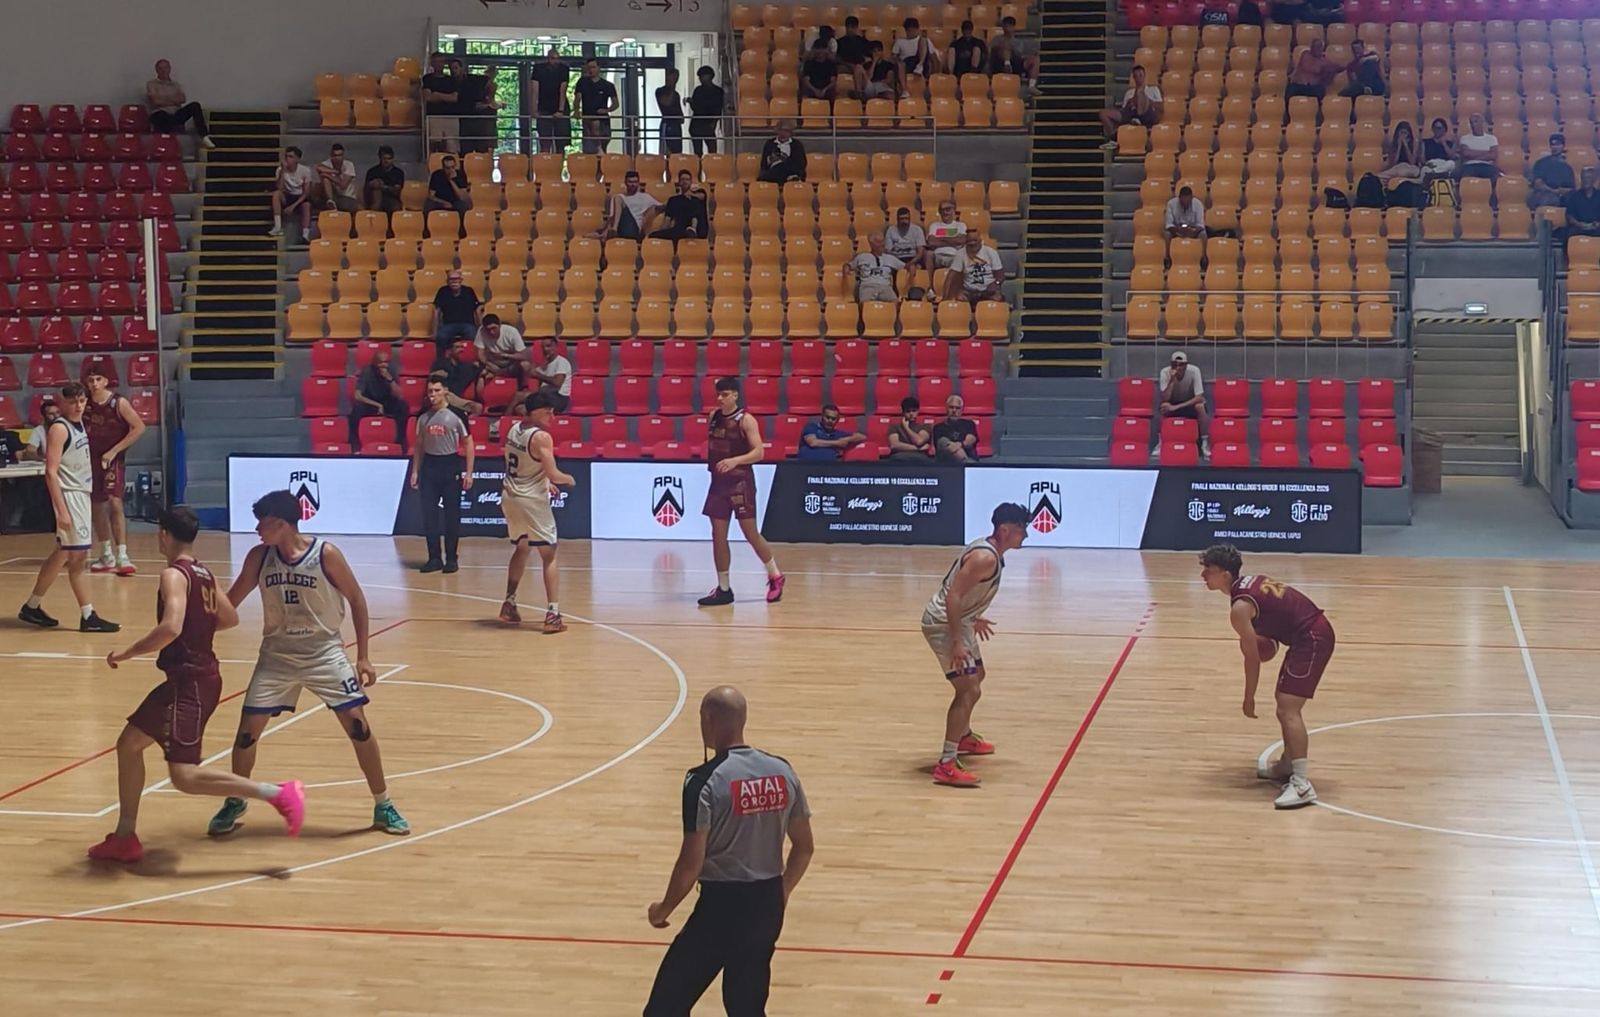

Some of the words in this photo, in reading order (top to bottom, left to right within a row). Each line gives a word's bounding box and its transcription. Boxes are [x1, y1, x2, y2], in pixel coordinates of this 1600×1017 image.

[290, 471, 318, 483] APU
[654, 476, 682, 488] APU
[1031, 482, 1060, 494] APU
[848, 498, 883, 511] Kellogg's
[1233, 504, 1271, 518] Kellogg's
[265, 573, 317, 589] COLLEGE
[284, 590, 300, 604] 12
[341, 677, 360, 695] 12
[741, 776, 783, 798] ATTAL
[741, 793, 784, 809] GROUP
